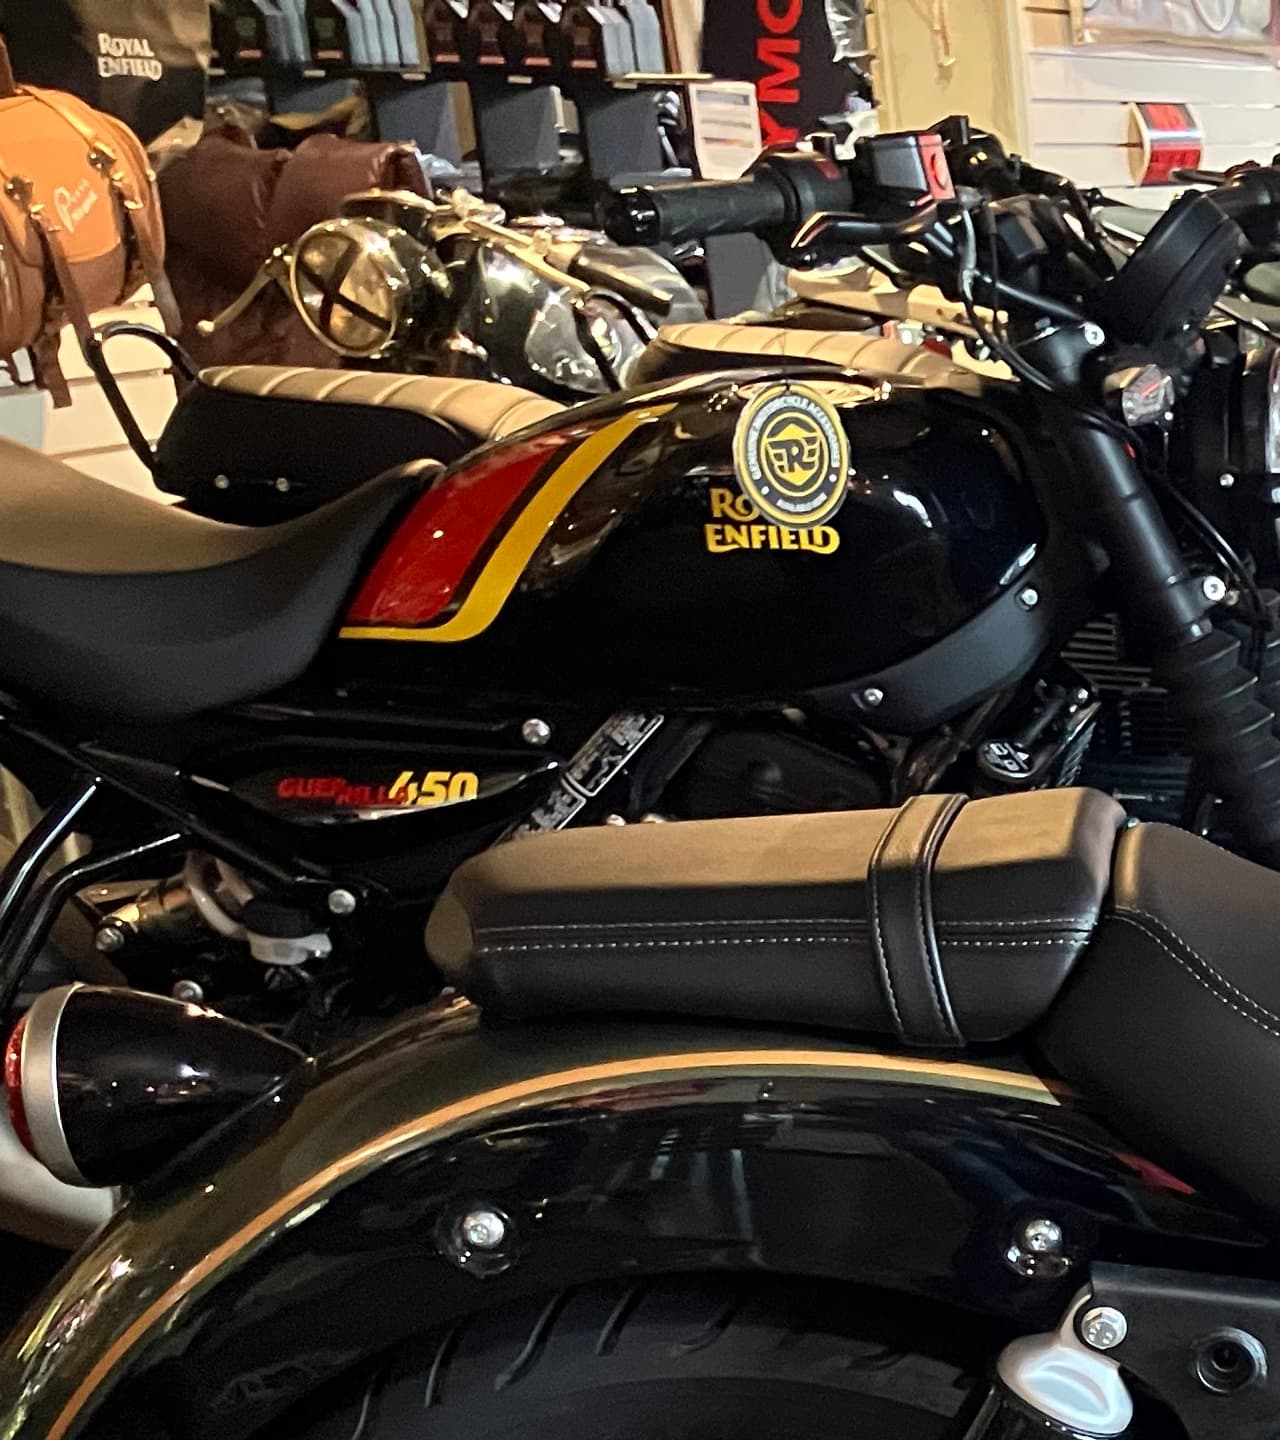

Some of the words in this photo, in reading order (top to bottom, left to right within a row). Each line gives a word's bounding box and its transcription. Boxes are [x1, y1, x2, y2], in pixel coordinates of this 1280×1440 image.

[97, 32, 155, 57] ROYAL
[97, 56, 163, 82] ENFIELD
[703, 523, 841, 555] ENFIELD
[388, 770, 480, 806] 450
